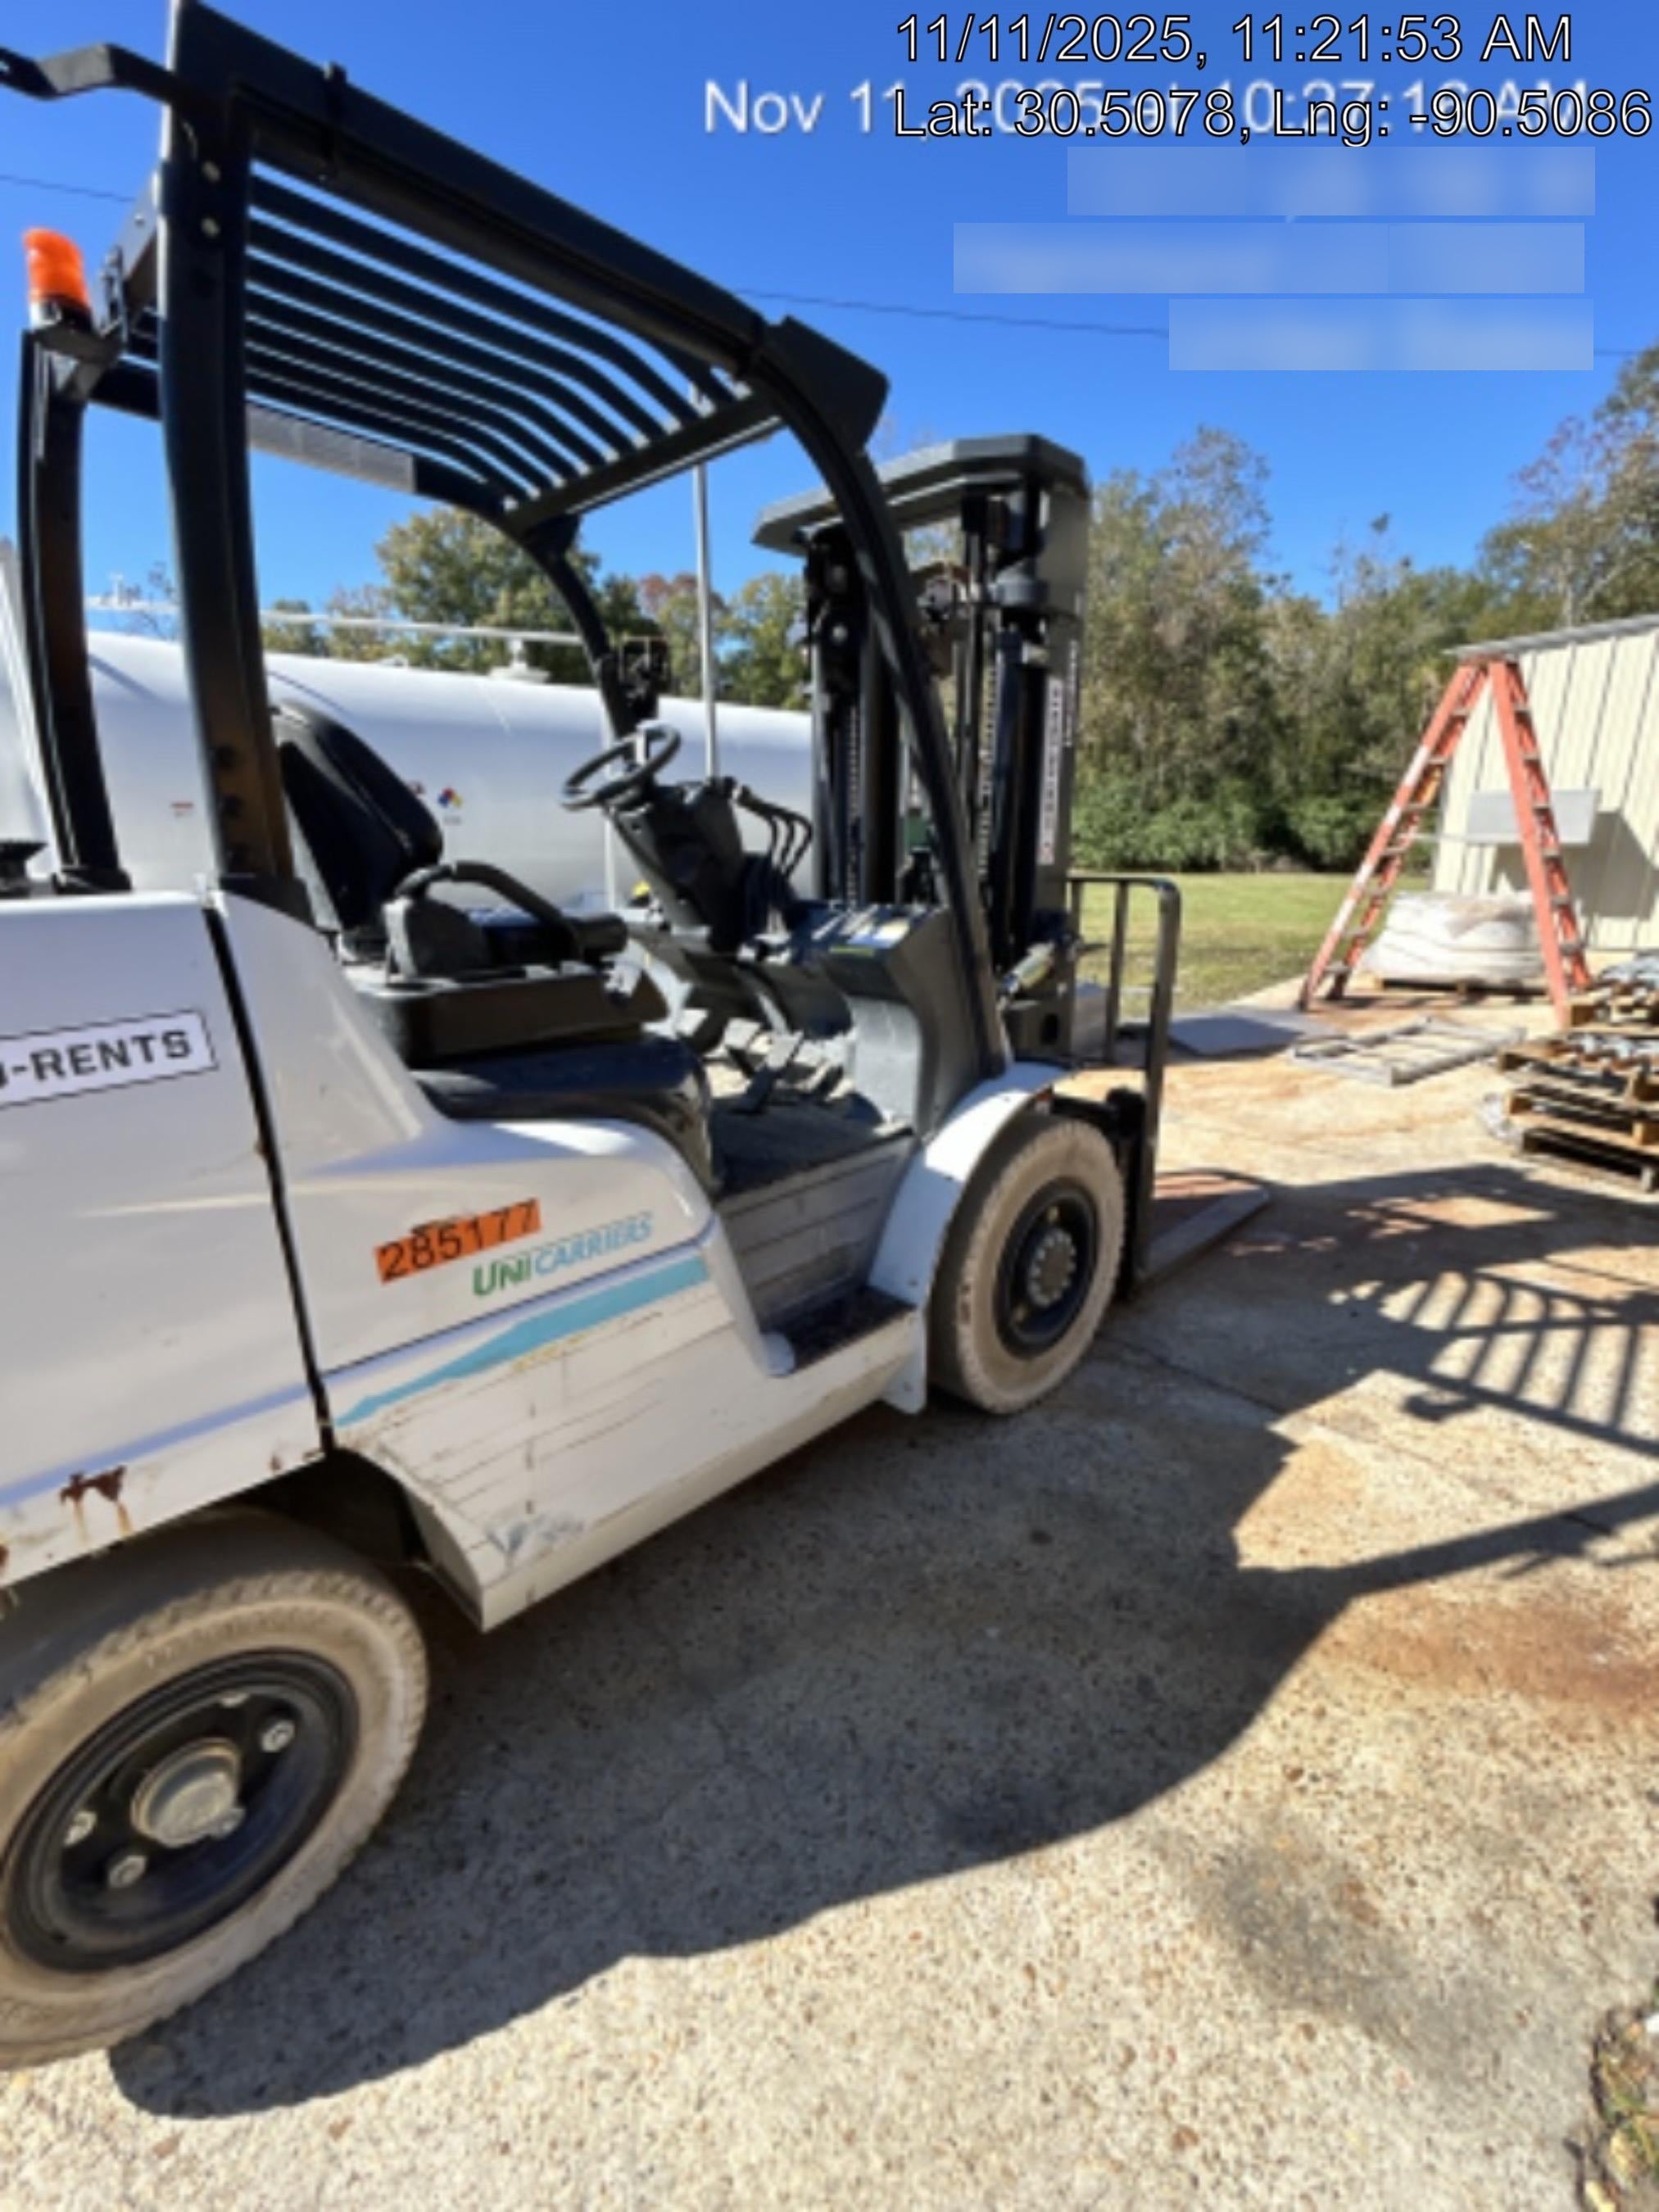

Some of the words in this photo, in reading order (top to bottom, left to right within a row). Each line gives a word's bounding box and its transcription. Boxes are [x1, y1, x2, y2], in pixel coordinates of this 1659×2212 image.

[0, 1029, 191, 1090] -RENTS
[377, 1198, 537, 1284] 285177
[472, 1209, 654, 1296] UNICARRIERS
